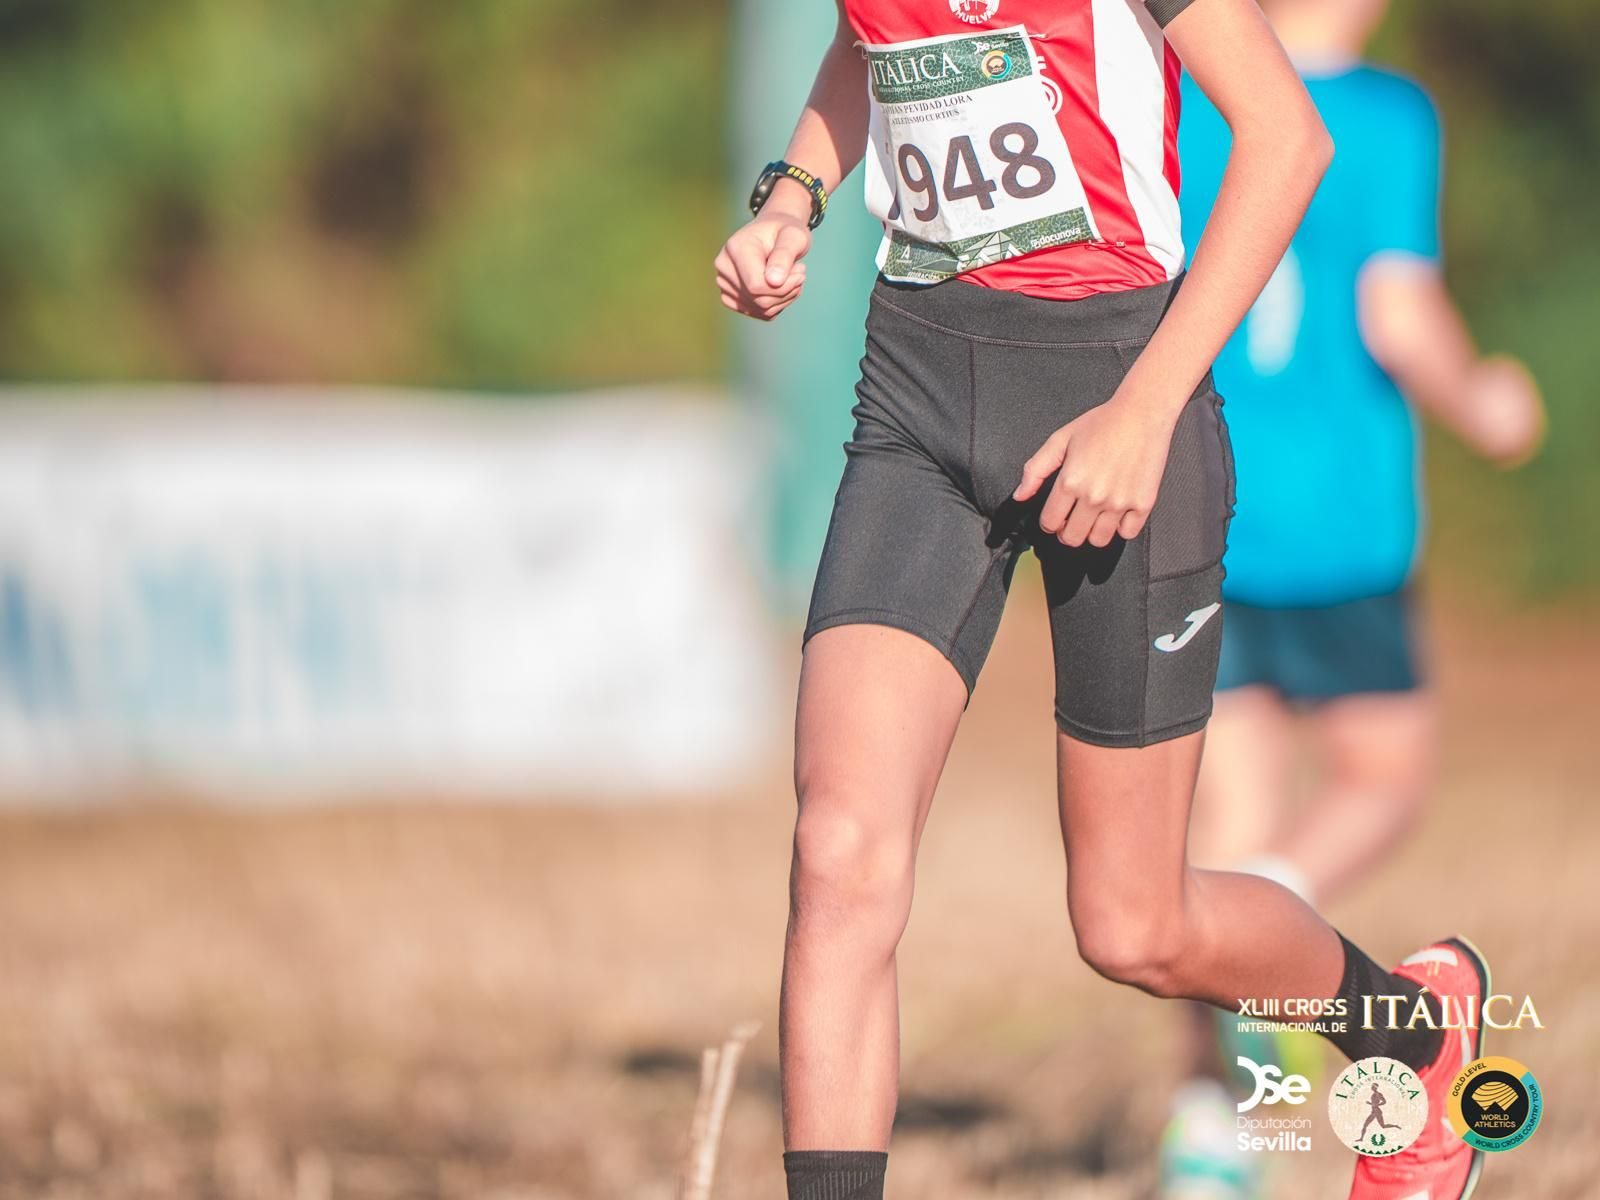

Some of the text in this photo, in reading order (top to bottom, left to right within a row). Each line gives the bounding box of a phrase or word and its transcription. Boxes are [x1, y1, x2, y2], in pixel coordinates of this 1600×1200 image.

[871, 50, 962, 86] ITÁLICA
[904, 100, 943, 114] PEVIDAD
[943, 94, 973, 108] LORA
